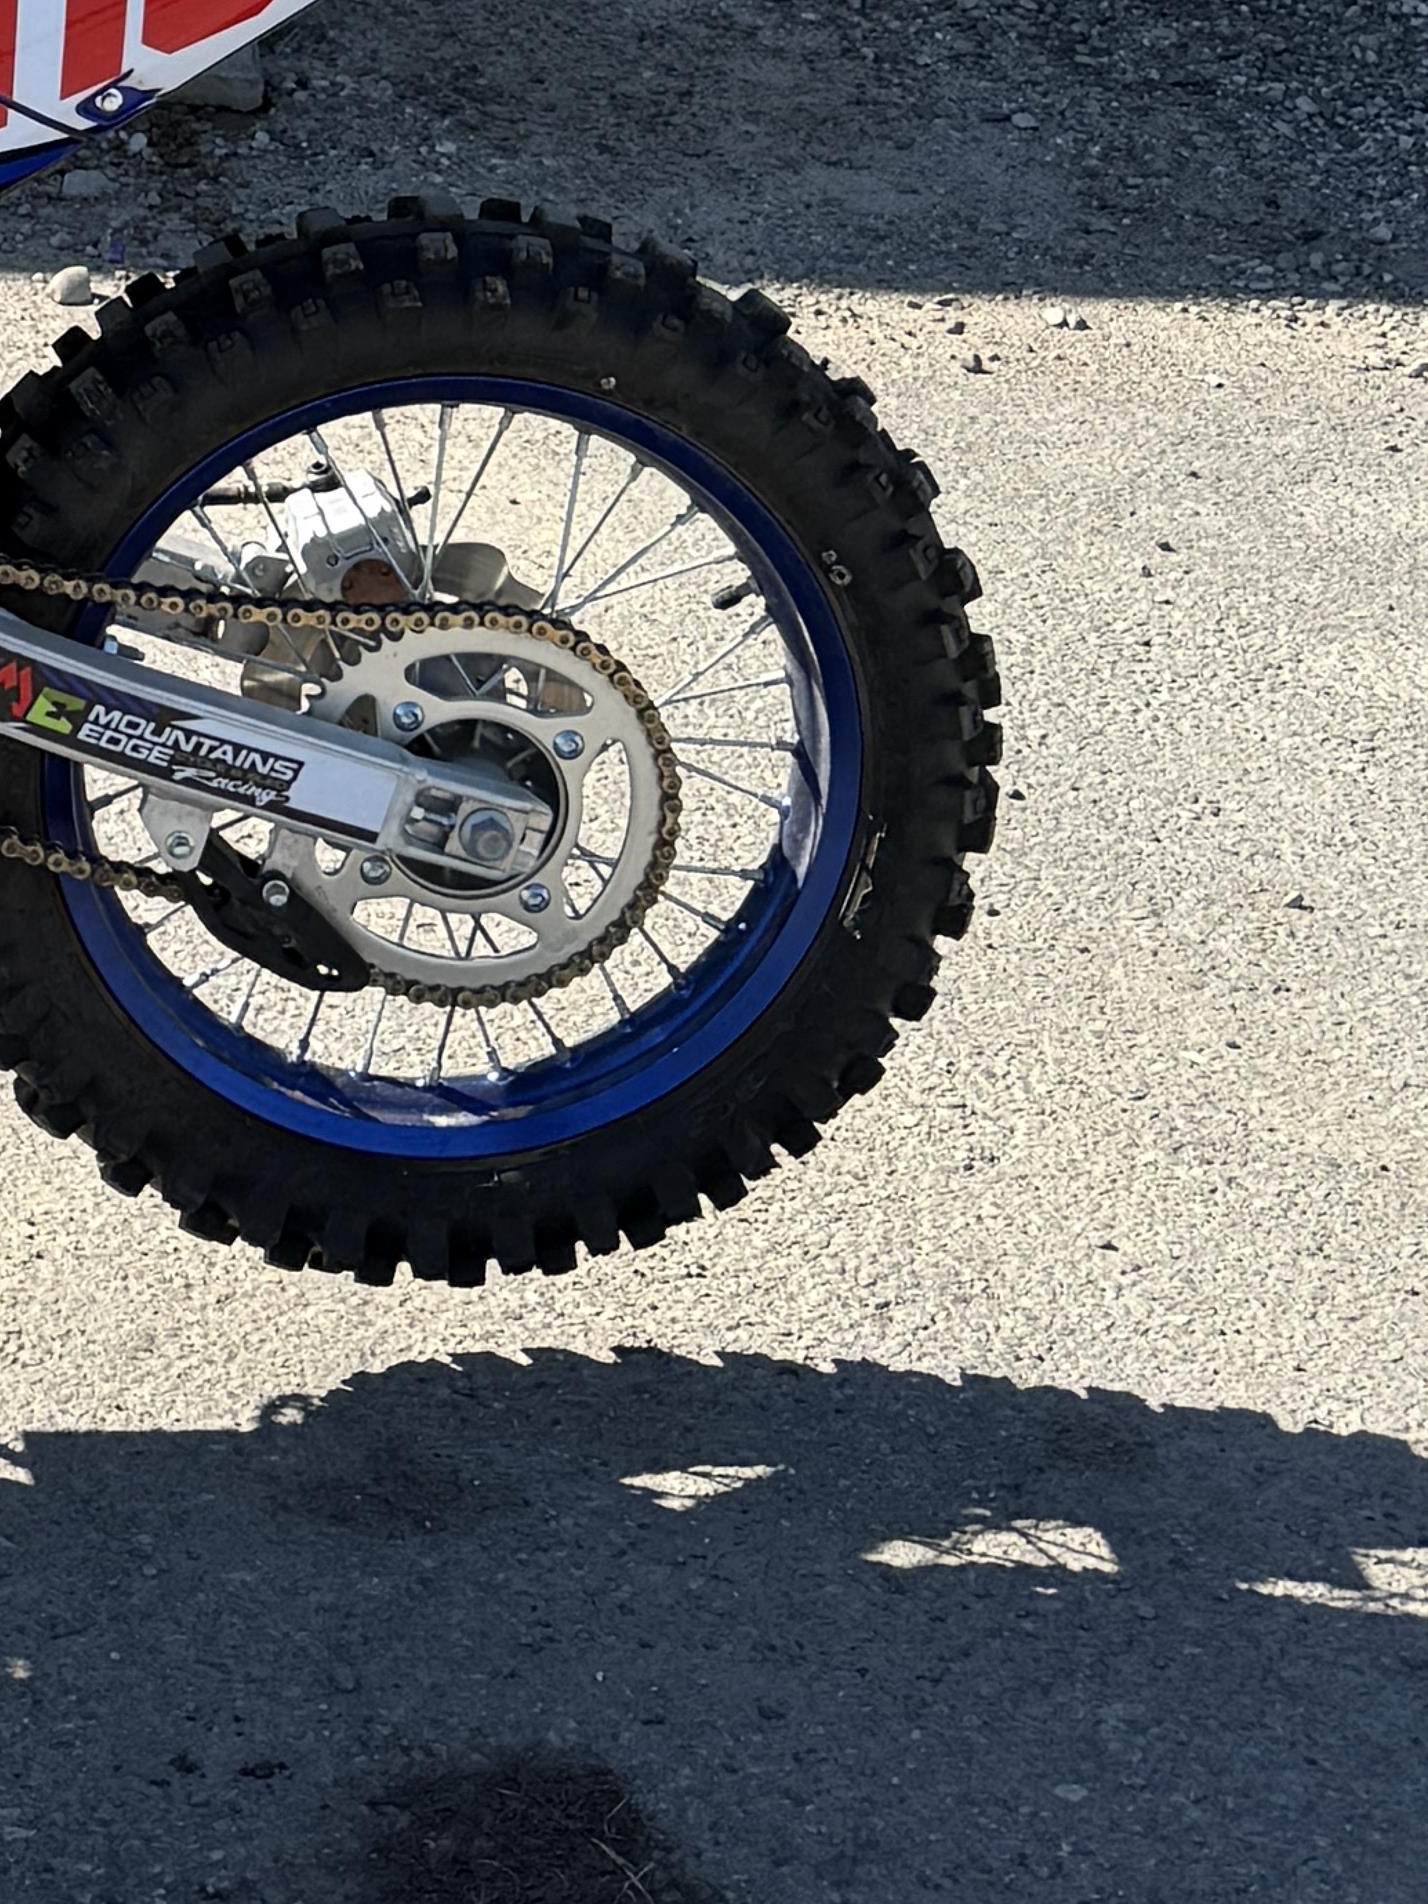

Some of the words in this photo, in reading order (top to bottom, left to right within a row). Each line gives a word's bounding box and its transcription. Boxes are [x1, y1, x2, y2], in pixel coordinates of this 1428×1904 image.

[76, 724, 176, 768] EDGE
[170, 765, 291, 807] Racing
[87, 703, 298, 782] MOUNTAINS
